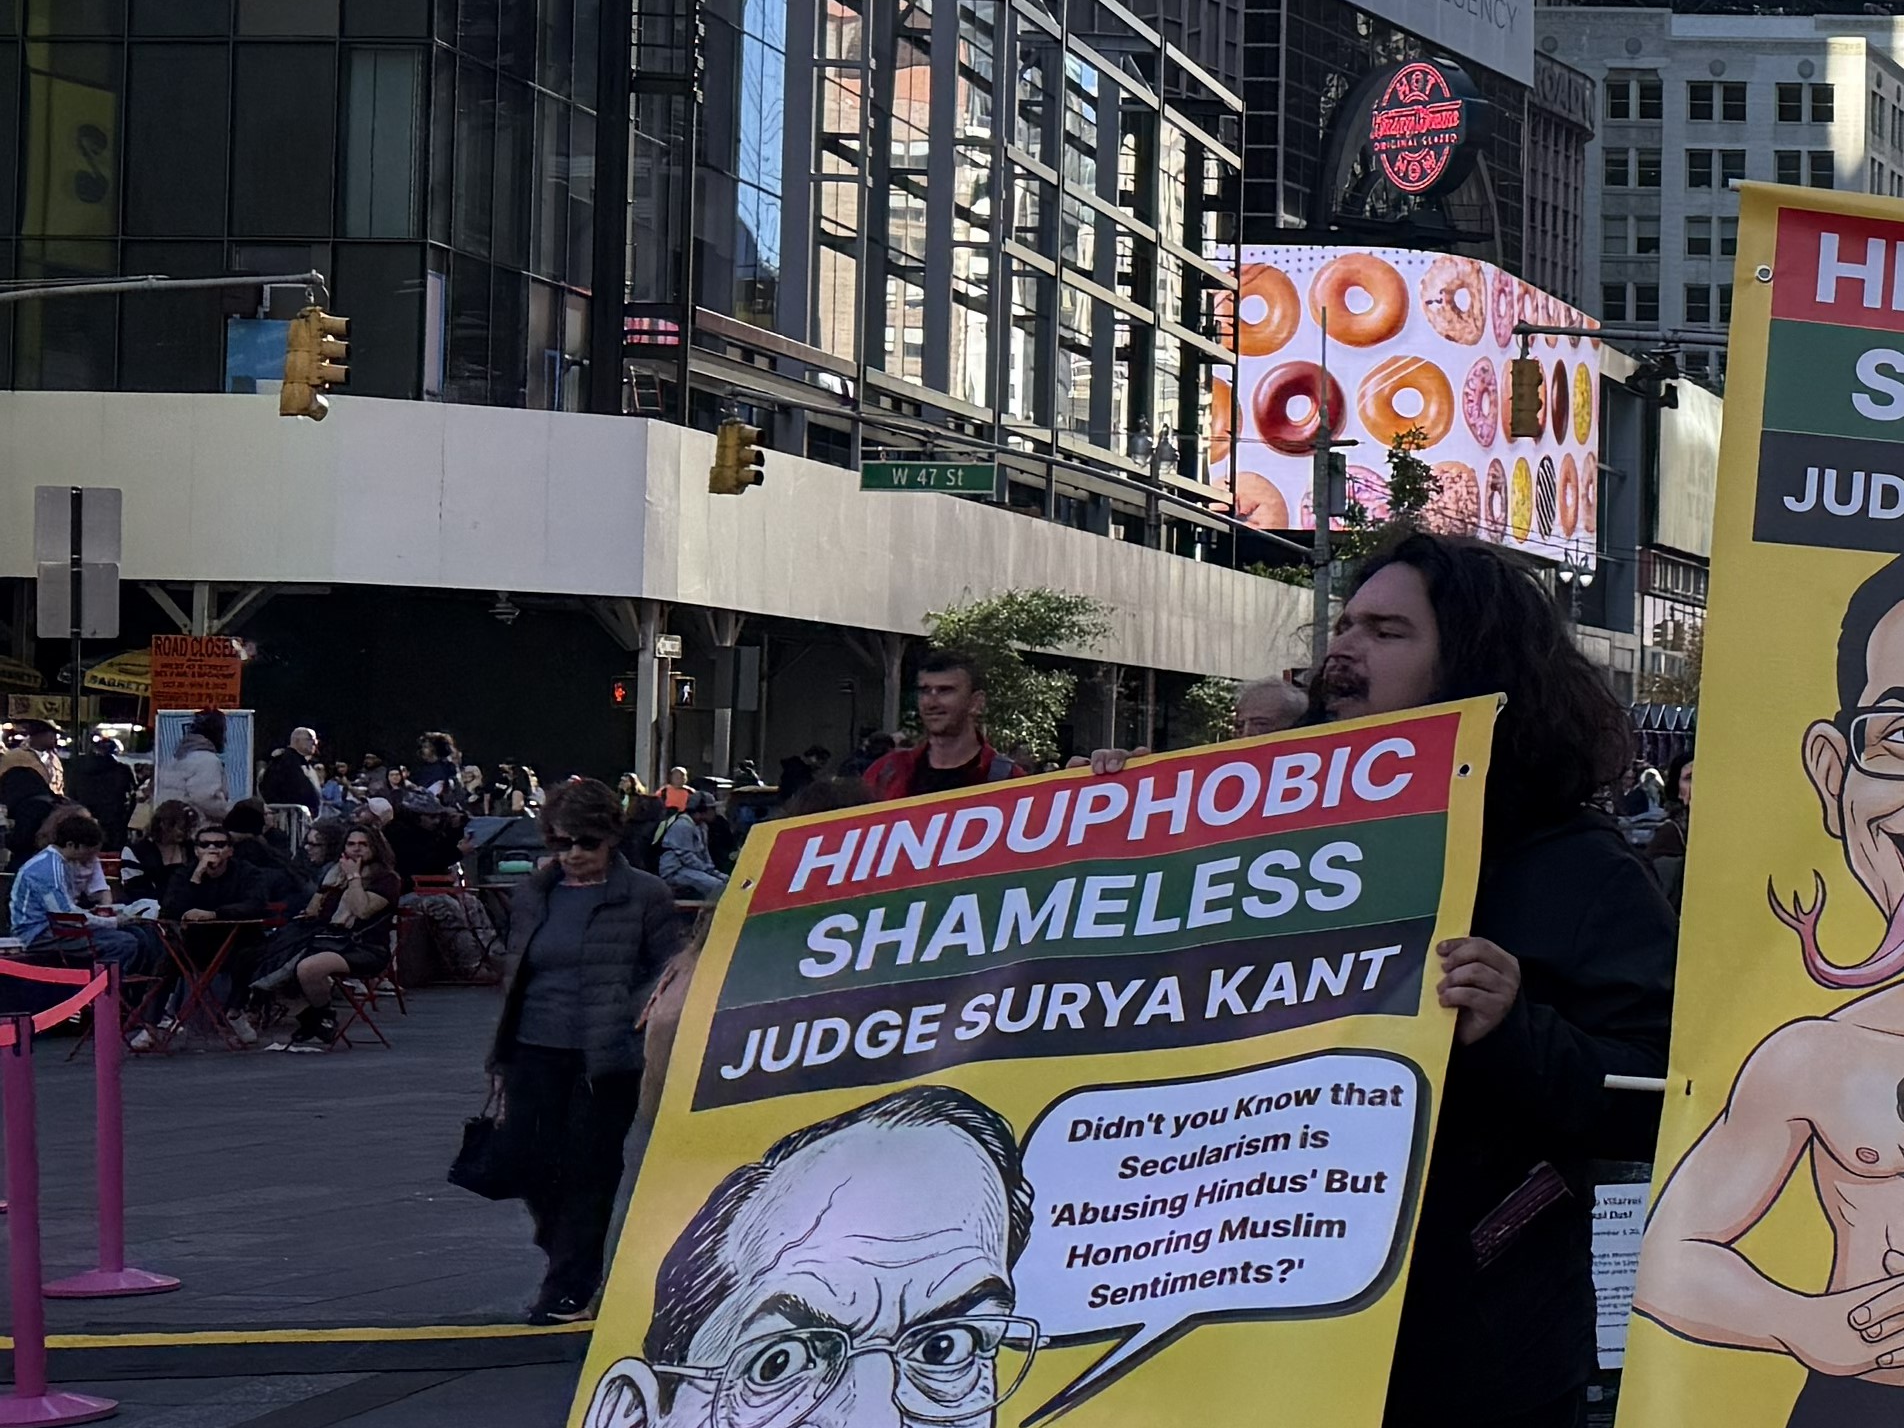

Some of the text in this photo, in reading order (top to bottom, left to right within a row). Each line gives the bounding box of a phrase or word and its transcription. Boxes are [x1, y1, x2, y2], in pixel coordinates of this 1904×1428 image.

[1374, 138, 1417, 151] ORIGINAL
[892, 468, 964, 486] W 47 St
[155, 637, 189, 657] ROAD
[787, 737, 1416, 893] HINDUPHOBIC
[799, 841, 1363, 979] SHAMELESS
[719, 945, 1402, 1080] JUDGE SURYA KANT
[1068, 1082, 1404, 1143] Didn't you Know that
[1118, 1124, 1329, 1180] Secularism is
[1050, 1169, 1387, 1230] 'Abusing Hindus' But
[1066, 1212, 1346, 1270] Honoring Muslim
[1088, 1258, 1304, 1310] Sentiments?'
